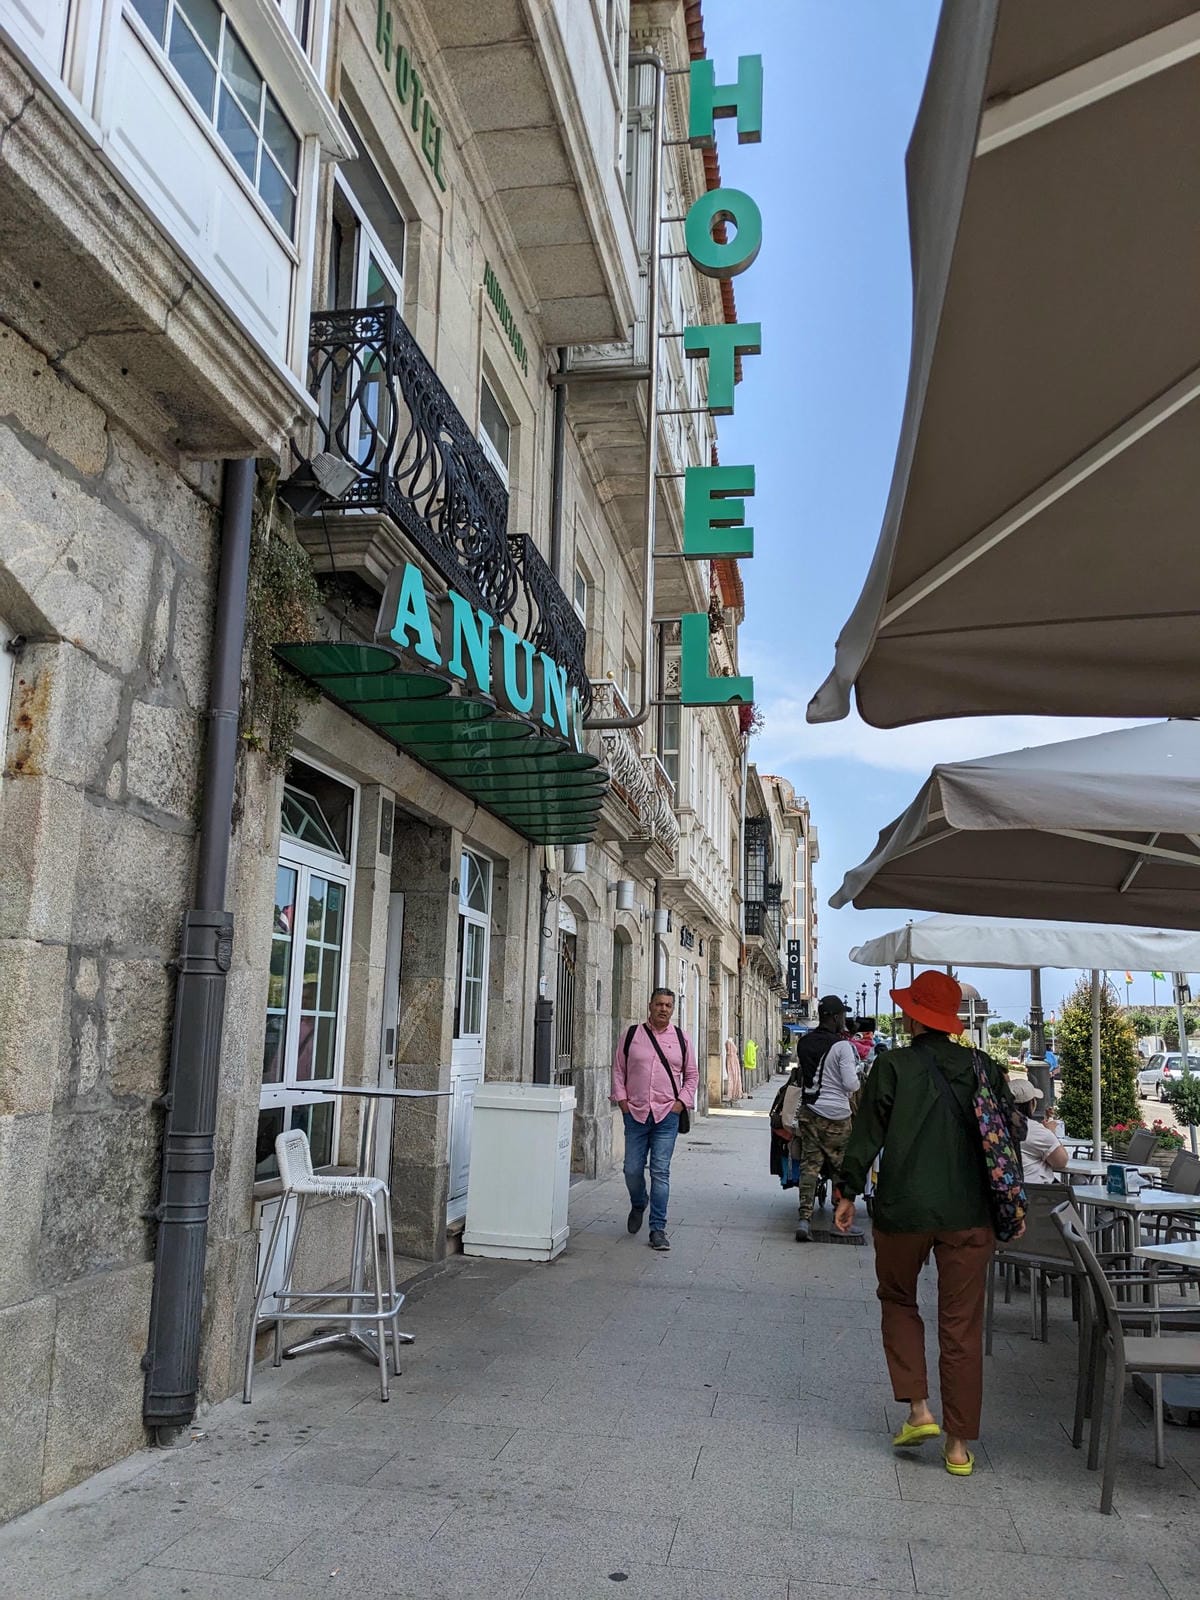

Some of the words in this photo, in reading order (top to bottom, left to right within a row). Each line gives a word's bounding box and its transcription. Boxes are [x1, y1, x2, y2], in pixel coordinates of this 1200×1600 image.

[376, 0, 446, 192] HOTEL
[681, 54, 764, 706] HOTEL
[789, 941, 799, 1002] HOTEL
